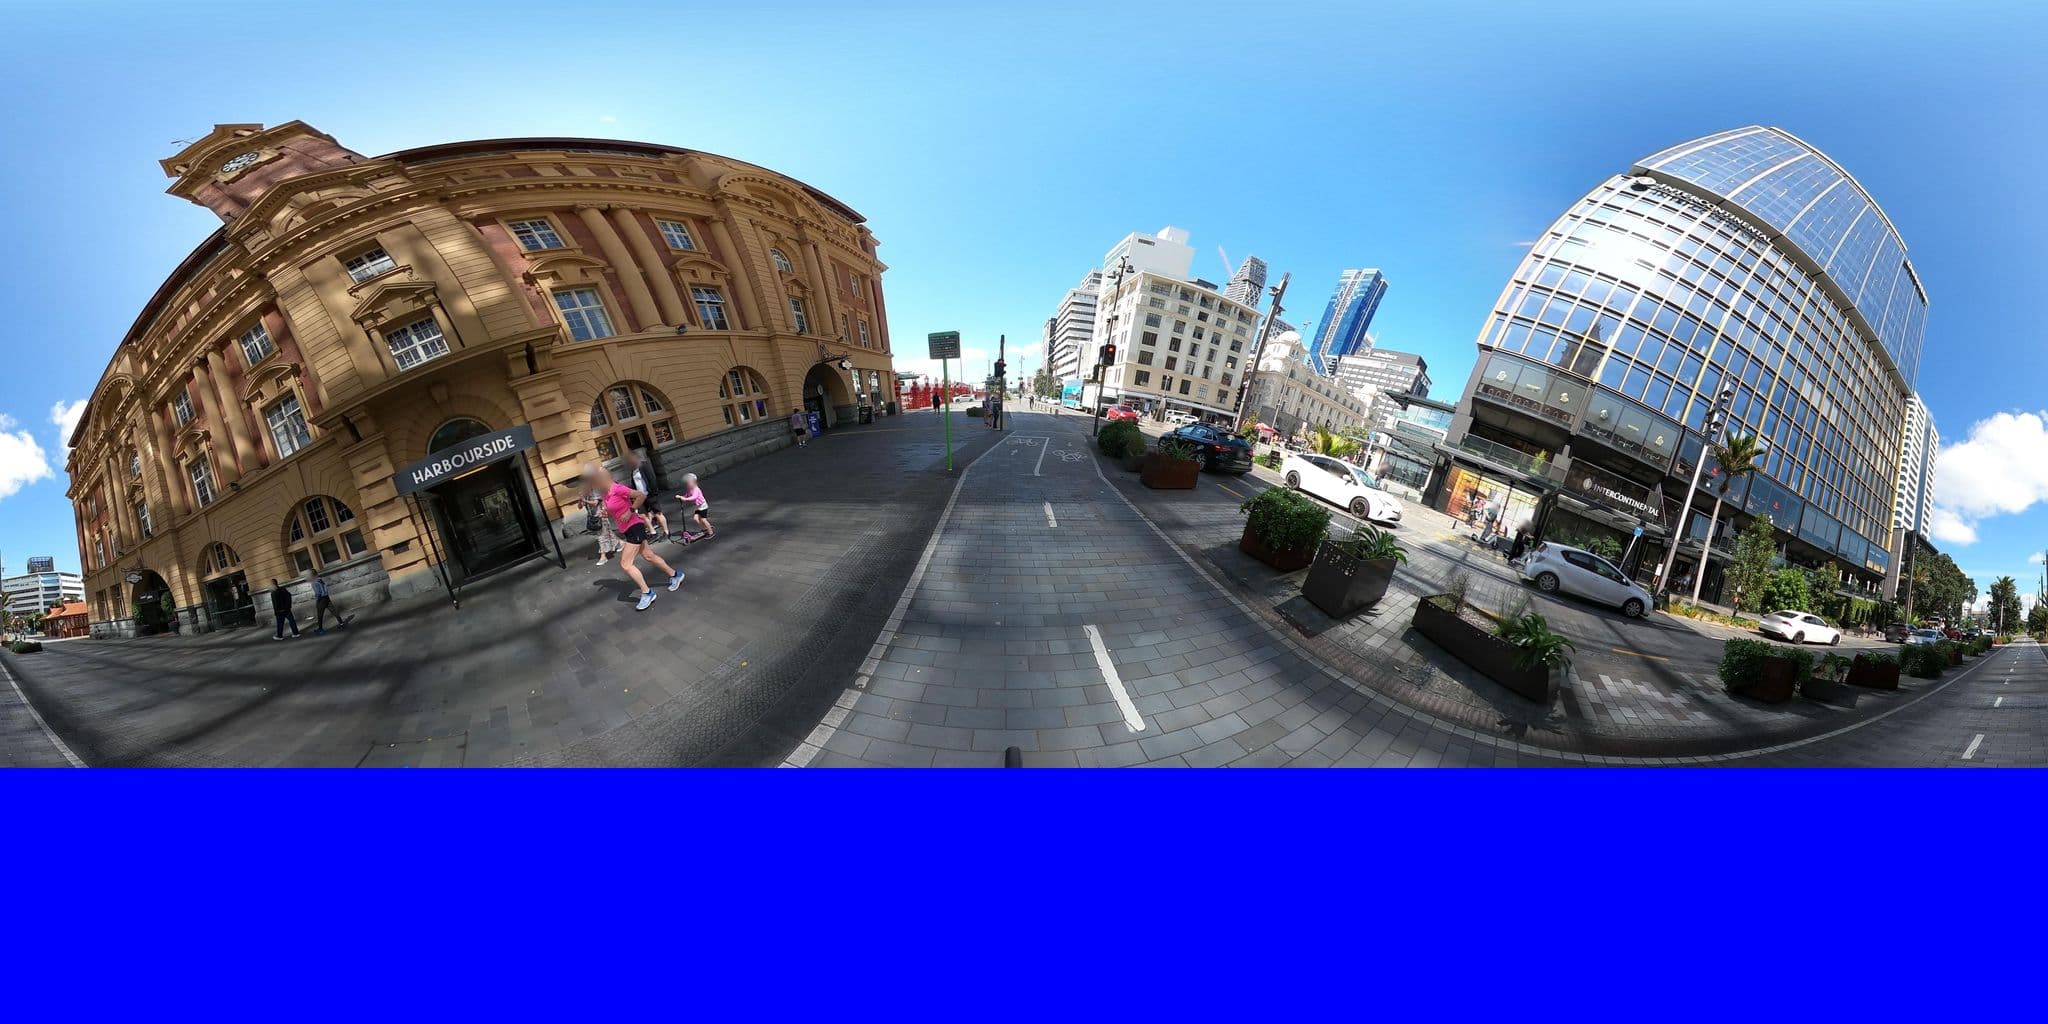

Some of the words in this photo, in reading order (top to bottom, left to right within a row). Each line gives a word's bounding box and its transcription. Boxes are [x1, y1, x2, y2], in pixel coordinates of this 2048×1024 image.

[1657, 183, 1772, 242] INTERCONTINENTAL
[412, 435, 515, 485] HARBOURSIDE
[1593, 483, 1659, 517] INTERCONTINENTAL
